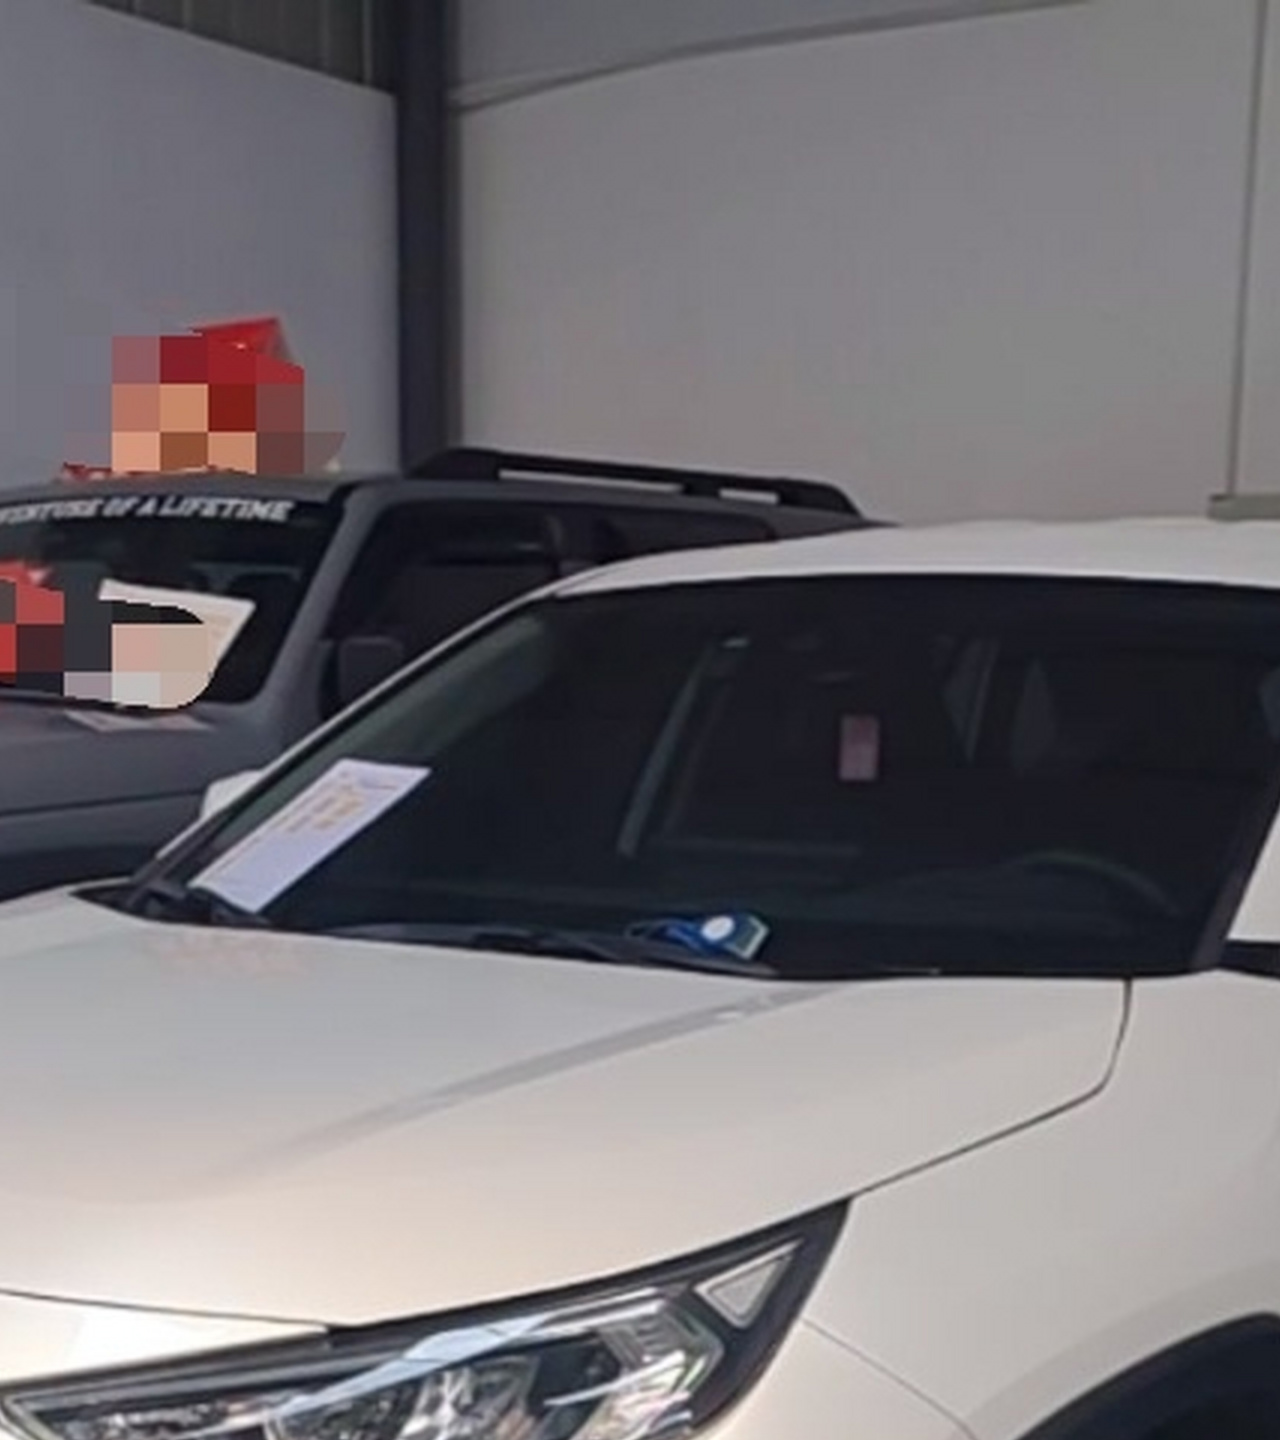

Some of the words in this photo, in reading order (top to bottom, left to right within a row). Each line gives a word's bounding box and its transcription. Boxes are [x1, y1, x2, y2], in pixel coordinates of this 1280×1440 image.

[102, 497, 139, 517] OF
[135, 498, 157, 516] A
[157, 497, 295, 522] LIFETIME
